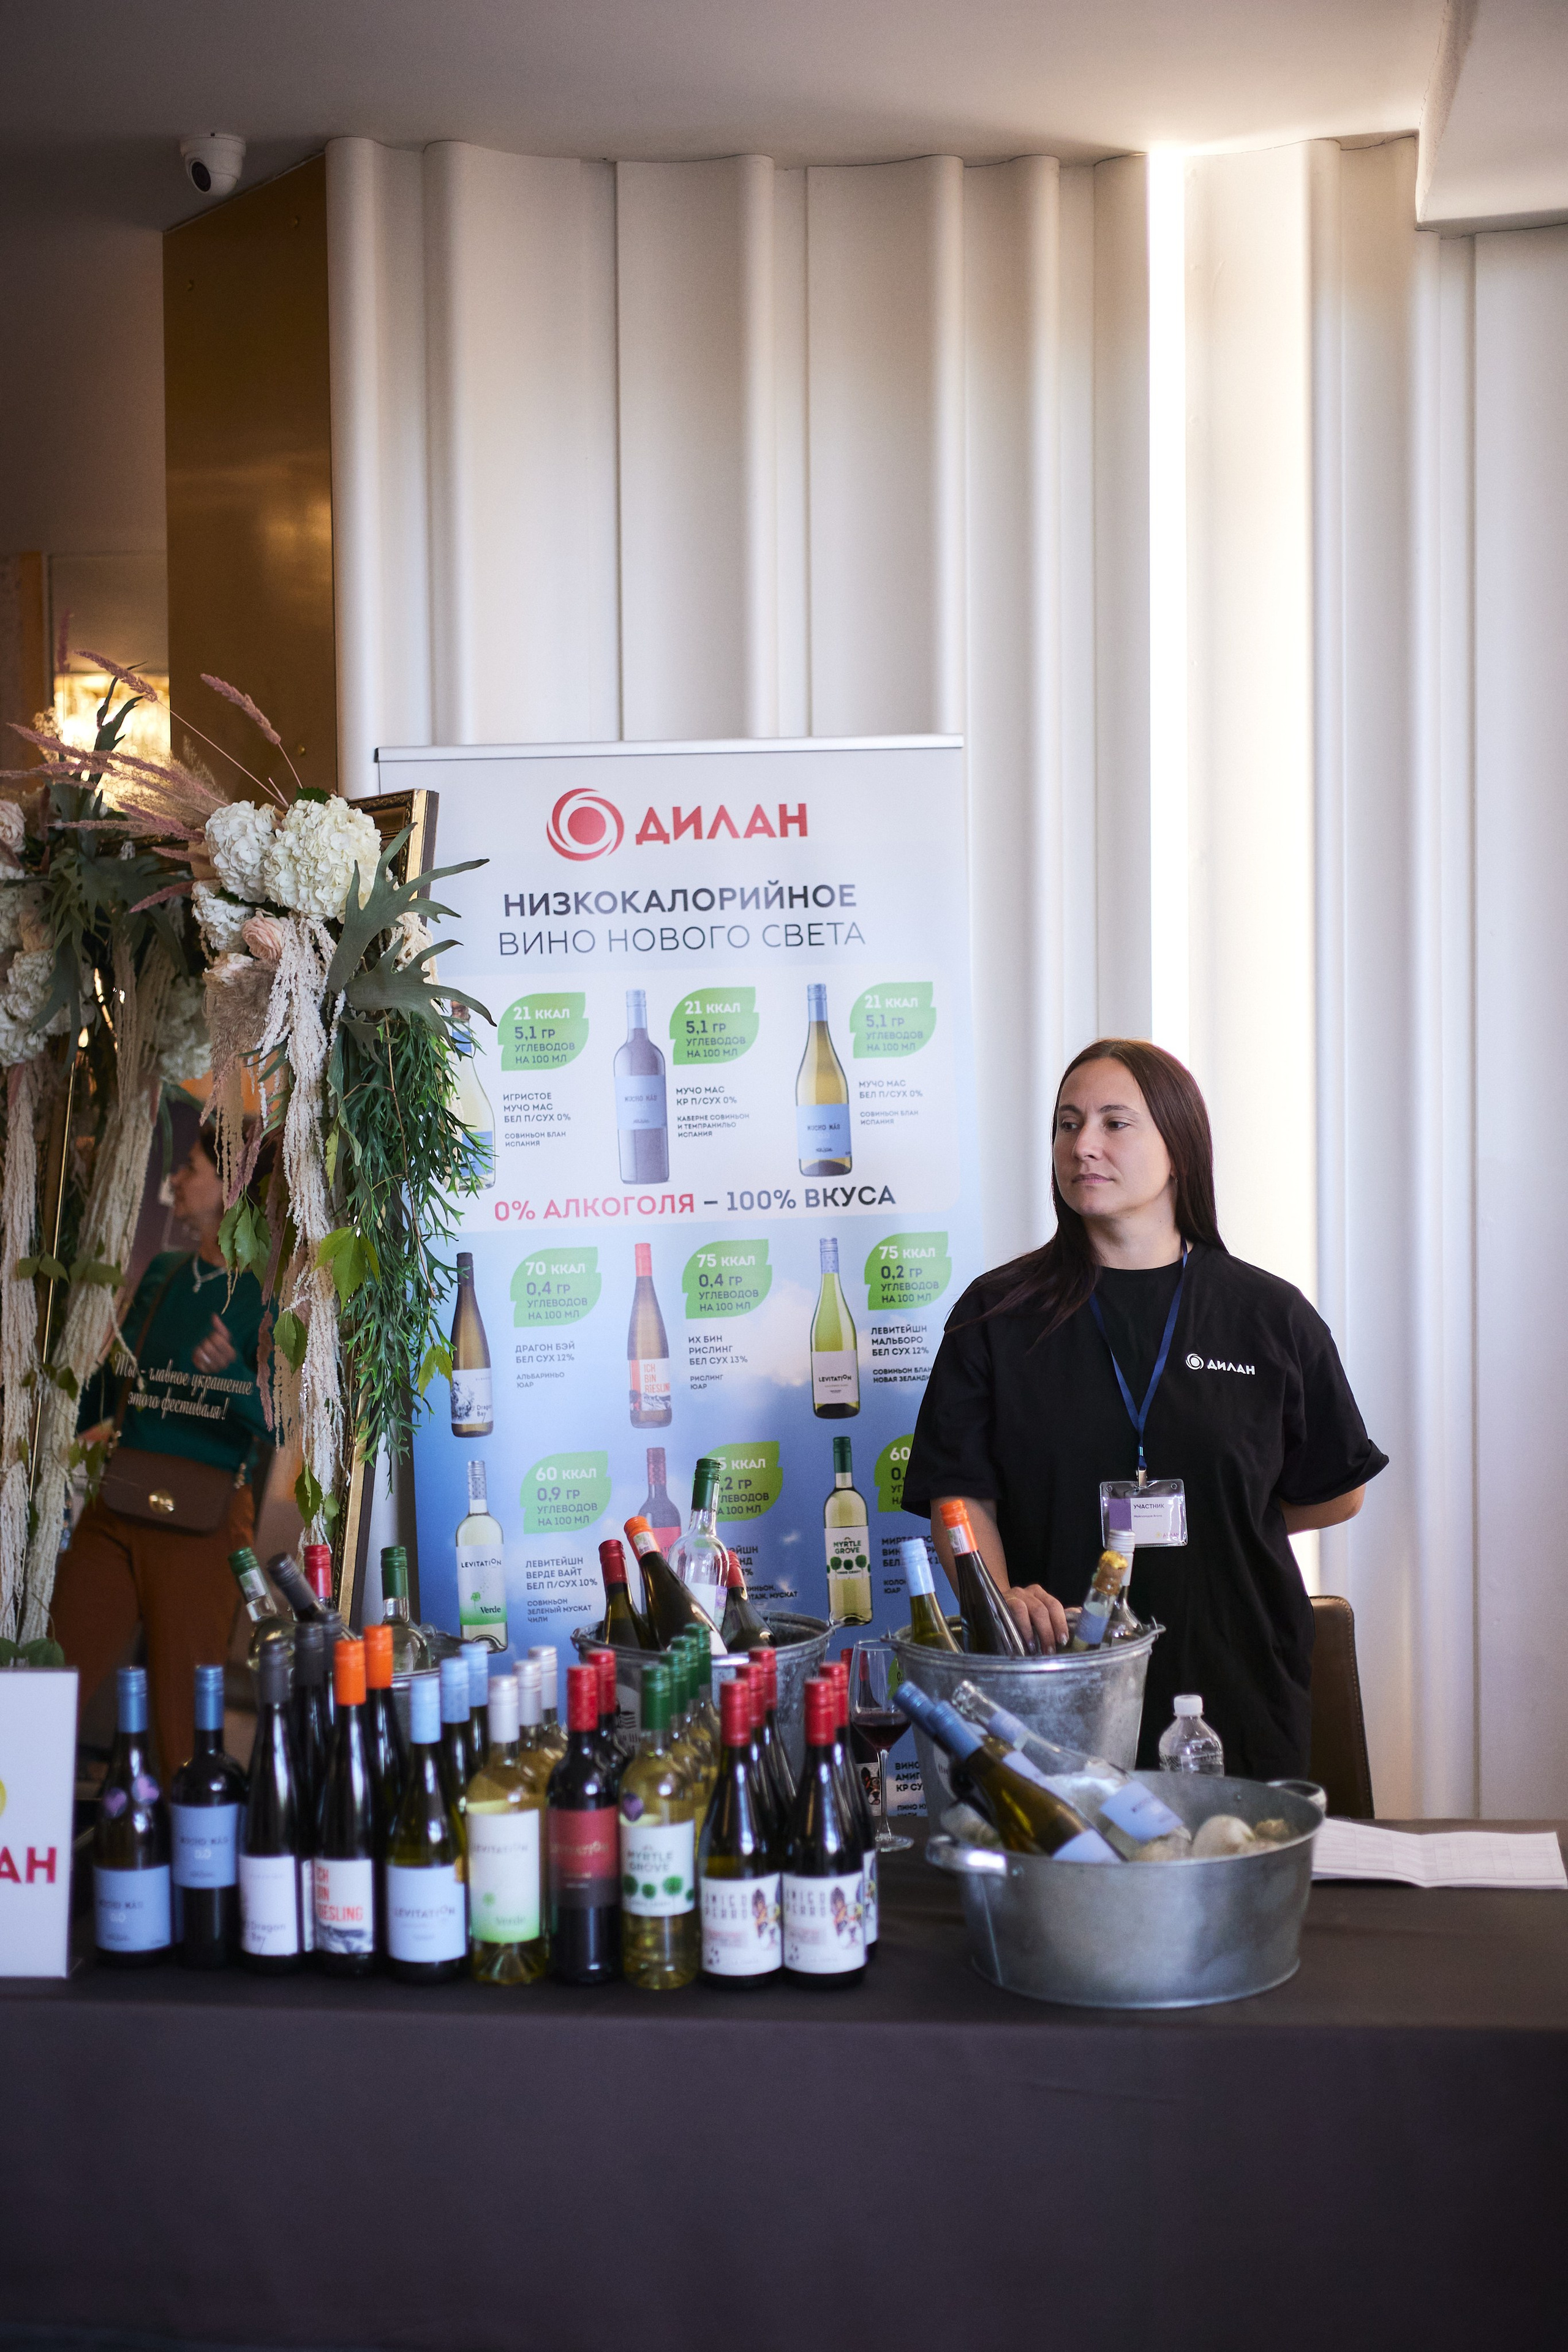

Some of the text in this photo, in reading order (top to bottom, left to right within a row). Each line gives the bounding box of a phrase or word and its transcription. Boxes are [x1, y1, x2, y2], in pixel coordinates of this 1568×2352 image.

[636, 803, 808, 845] ДИЛАН
[504, 880, 856, 917] НИЗКОКАЛОРИЙНОЕ
[500, 922, 865, 956] ВИНО НОВОГО СВЕТА
[513, 1006, 570, 1020] 21 ККАЛ
[685, 1001, 740, 1014] 21 ККАЛ
[514, 1026, 555, 1040] 5,1 ГР
[686, 1020, 726, 1035] 5,1 ГР
[515, 1042, 575, 1052] УГЛЕВОДОВ
[687, 1037, 745, 1046] УГЛЕВОДОВ
[525, 1114, 554, 1122] П/СУХ
[494, 1185, 896, 1221] 0% АЛКОГОЛЯ 100% ВКУСА
[879, 1246, 935, 1260] 75 ККАЛ
[697, 1254, 755, 1268] 75 ККАЛ
[526, 1262, 586, 1276] 70 ККАЛ
[881, 1265, 922, 1280] 0,2 ГР
[699, 1274, 742, 1288] 0,4 ГР
[881, 1281, 938, 1292] УГЛЕВОДОВ
[527, 1281, 570, 1296] 0,4 ГР
[699, 1290, 758, 1300] УГЛЕВОДОВ
[527, 1297, 587, 1308] УГЛЕВОДОВ
[700, 1303, 714, 1312] НА
[871, 1324, 927, 1335] ЛЕВИТЕЙШН
[872, 1336, 923, 1345] МАЛЬБОРО
[516, 1341, 575, 1353] ДРАГОН БЭЙ
[690, 1346, 733, 1354] РИСЛИНГ
[644, 1363, 655, 1373] ICH
[1207, 1359, 1255, 1375] ДИЛАН
[149, 1359, 190, 1386] главное
[190, 1373, 253, 1396] украшение
[644, 1374, 657, 1382] BIN
[128, 1387, 230, 1420] этого фестиваля!
[890, 1447, 911, 1461] 60
[535, 1467, 596, 1482] 60 ККАЛ
[537, 1487, 579, 1502] 0,9 ГР
[537, 1503, 597, 1514] УГЛЕВОДОВ
[538, 1518, 552, 1526] НА
[555, 1517, 571, 1525] 100
[461, 1558, 501, 1568] LEVITATION
[526, 1557, 583, 1568] ЛЕВИТЕЙШН
[527, 1567, 582, 1579] ВЕРДЕ ВАЙТ
[548, 1580, 577, 1589] П/СУХ
[480, 1606, 501, 1615] Verde
[528, 1606, 560, 1615] ЗЕЛЕНЫЙ
